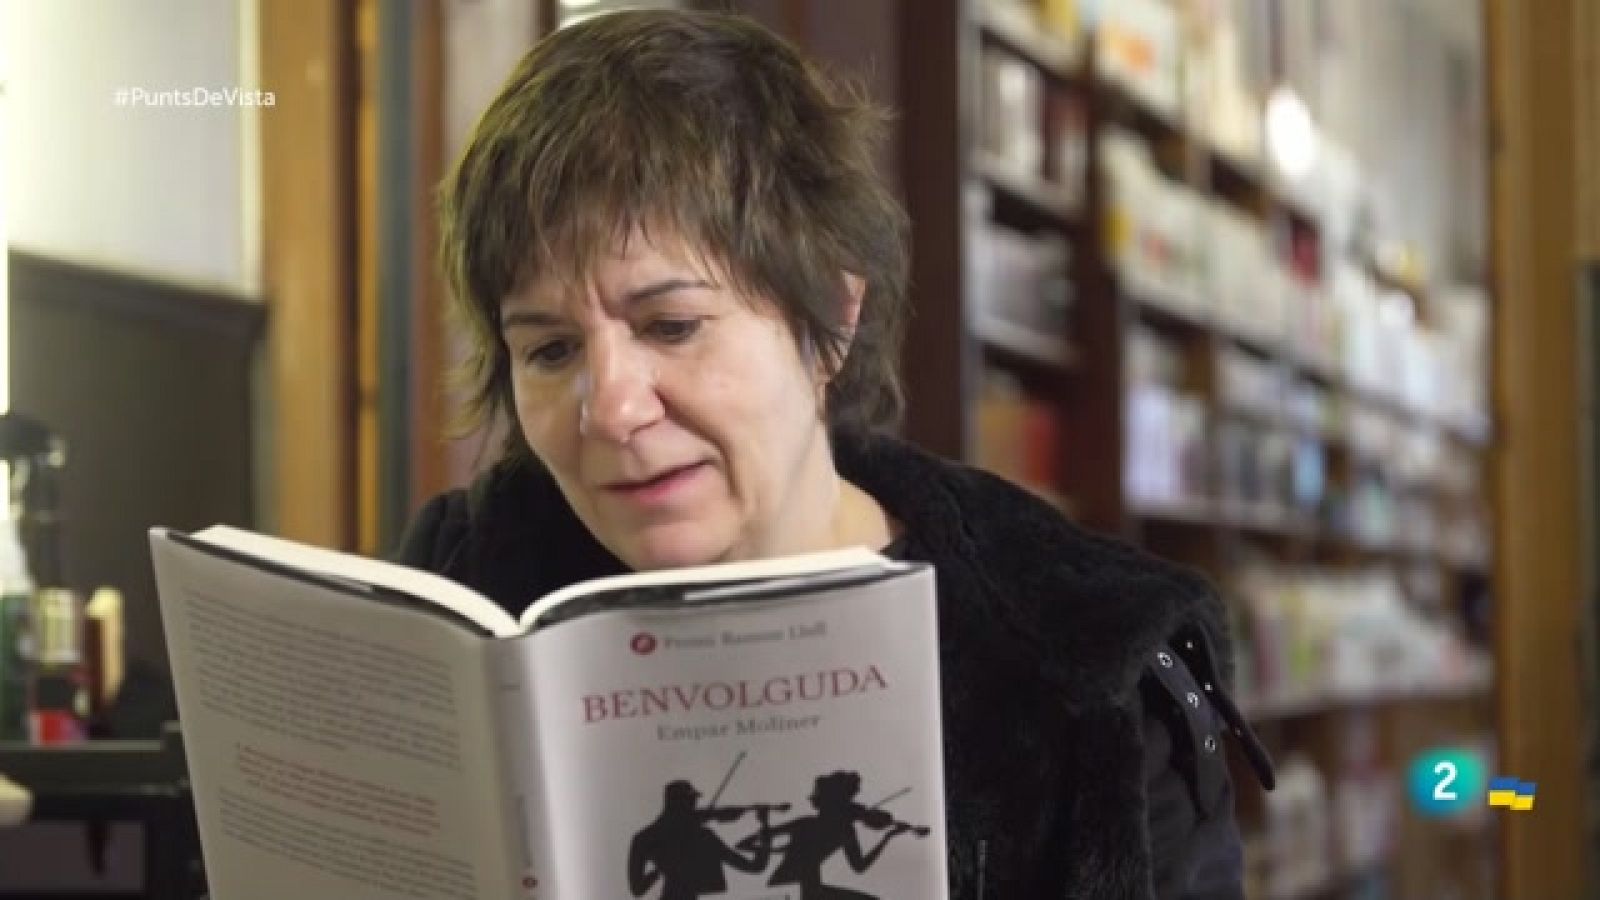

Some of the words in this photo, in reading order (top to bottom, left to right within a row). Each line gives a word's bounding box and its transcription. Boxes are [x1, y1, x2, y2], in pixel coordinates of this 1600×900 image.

[581, 664, 888, 723] BENVOLGUDA
[656, 723, 729, 742] Empar
[735, 714, 821, 736] Moliner
